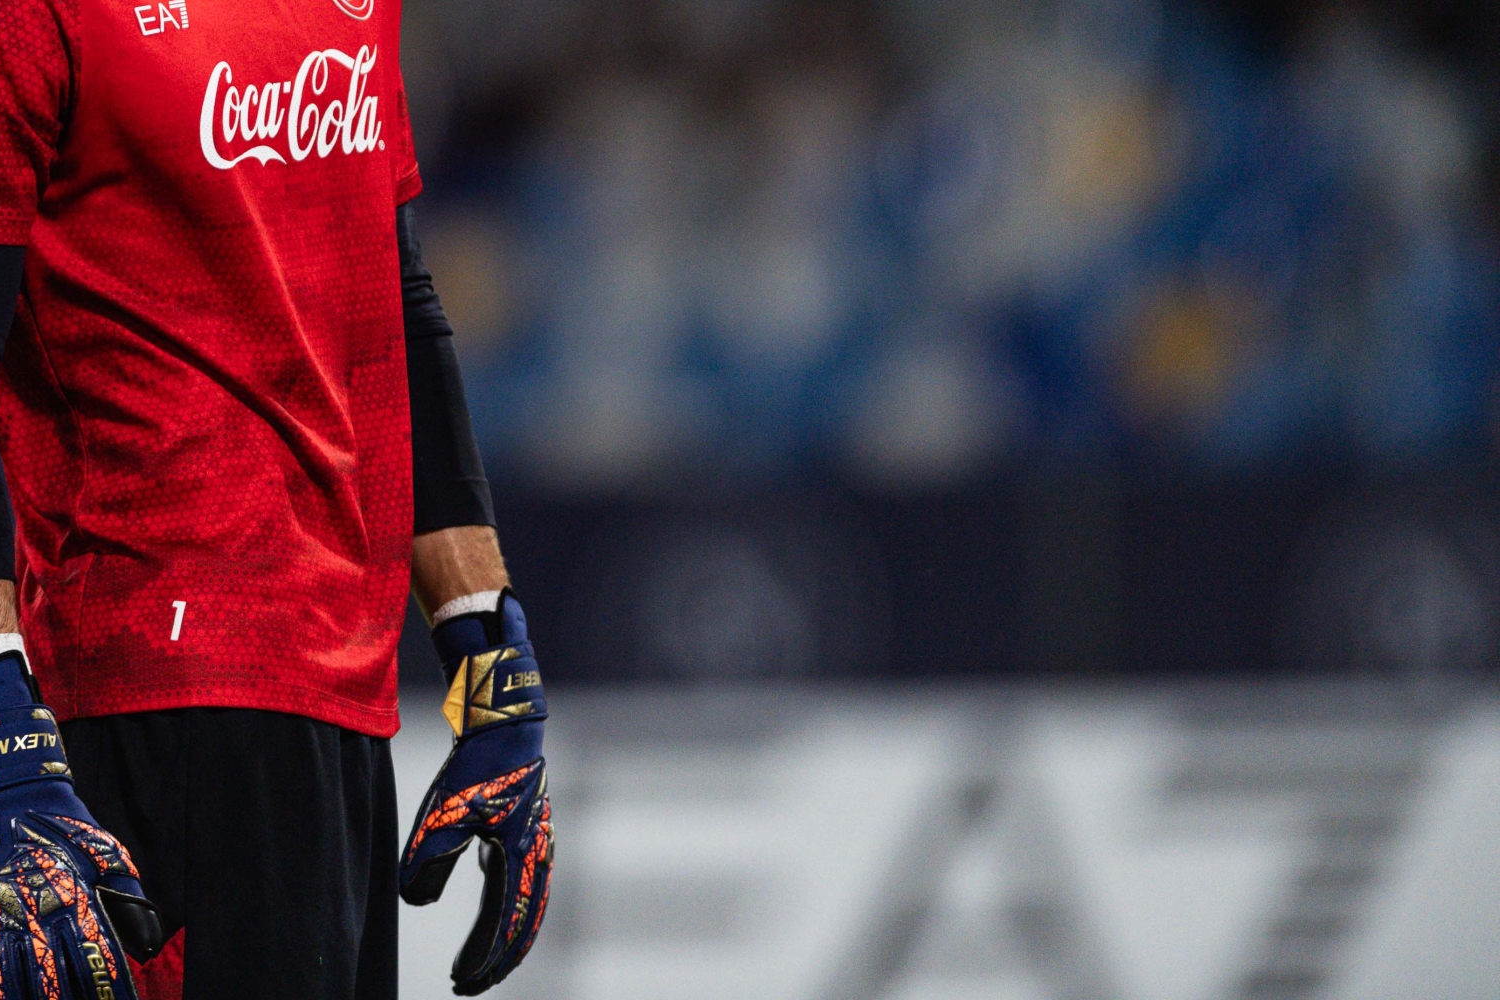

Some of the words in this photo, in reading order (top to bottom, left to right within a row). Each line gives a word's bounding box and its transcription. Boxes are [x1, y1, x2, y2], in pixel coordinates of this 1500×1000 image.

[134, 0, 189, 36] EA7
[200, 44, 383, 170] Coca-Cola
[170, 600, 187, 642] 1
[502, 670, 542, 692] ERET
[13, 732, 57, 752] ALEX
